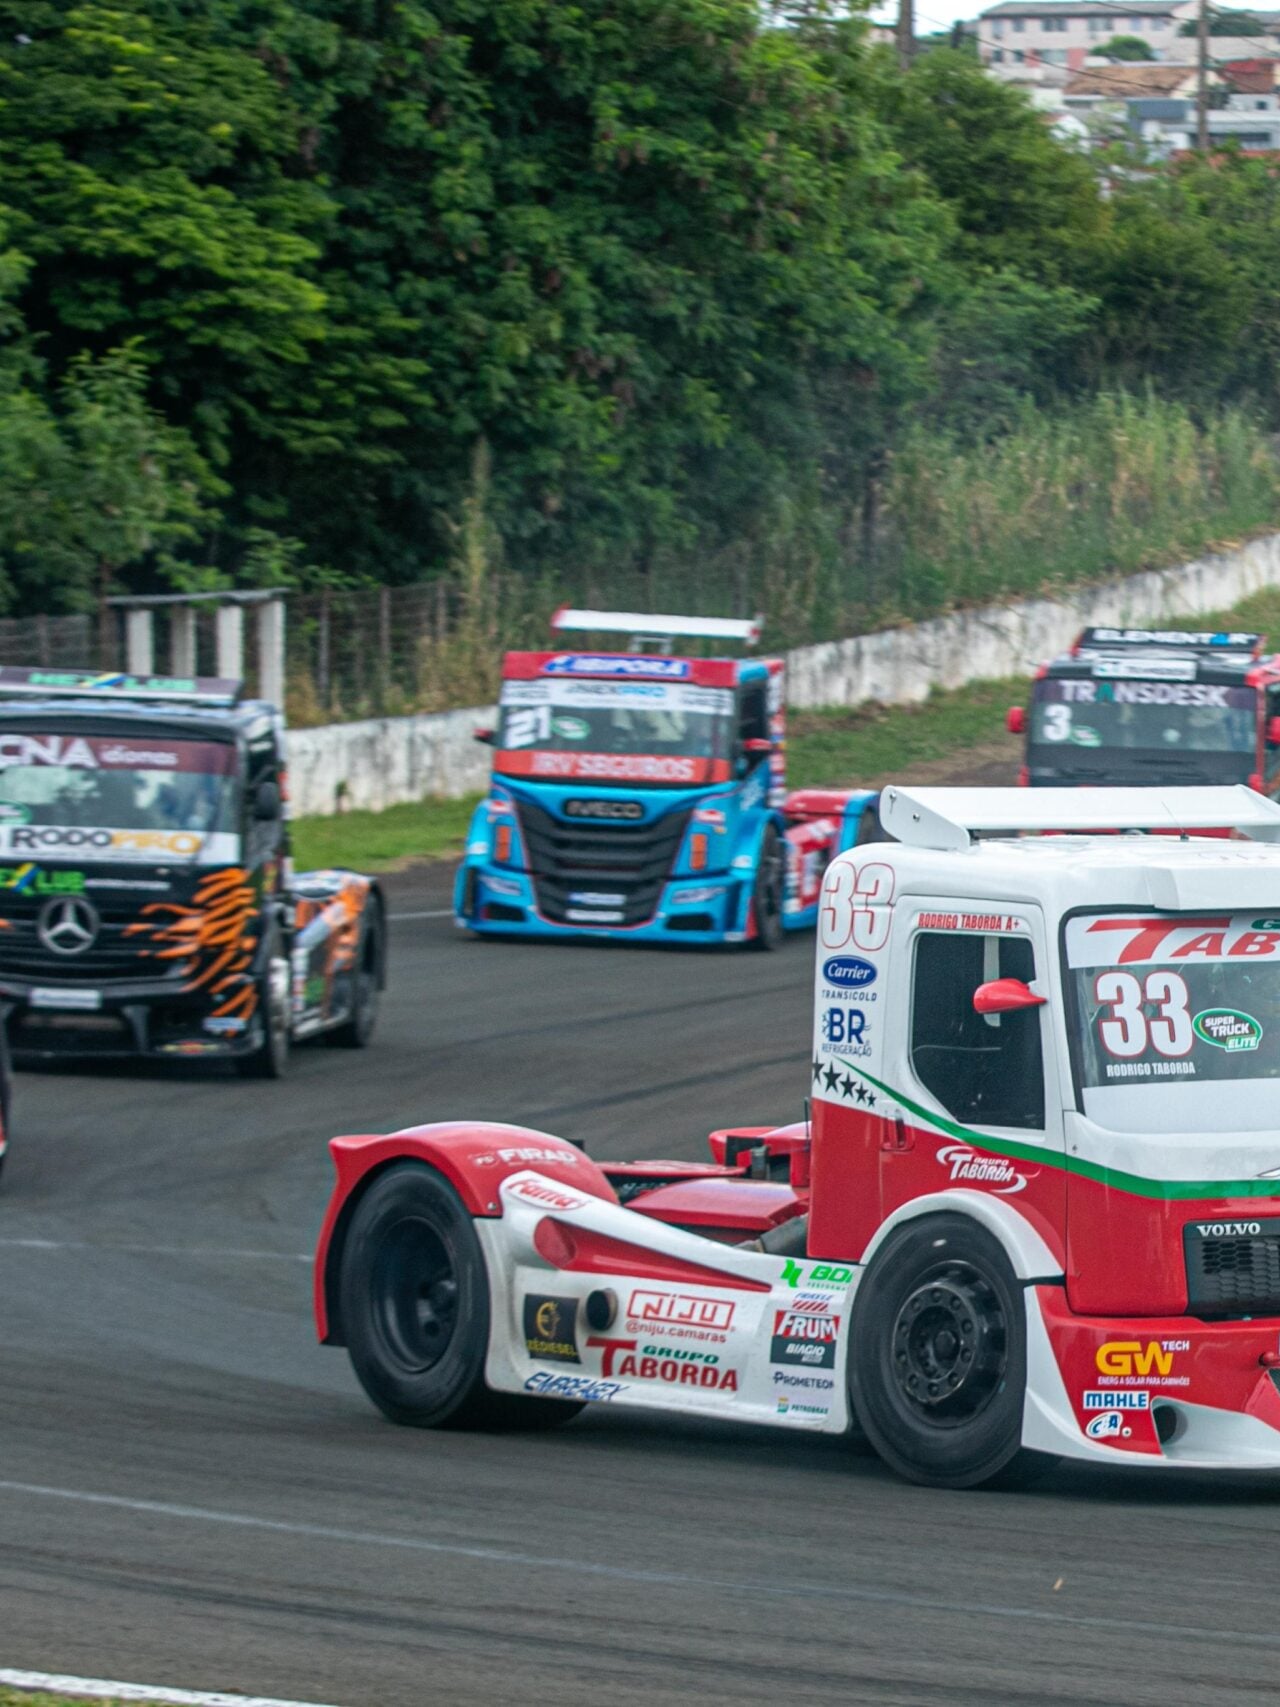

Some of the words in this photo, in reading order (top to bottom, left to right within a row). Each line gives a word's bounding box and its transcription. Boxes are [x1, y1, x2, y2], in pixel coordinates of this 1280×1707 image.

[1059, 680, 1230, 707] TRANSDESK
[506, 705, 551, 749] 21
[1044, 704, 1072, 741] 3
[577, 754, 694, 779] SEGUROS
[820, 861, 896, 951] 33
[918, 913, 957, 929] RODRIGO
[961, 914, 1002, 930] TABORDA
[828, 962, 871, 980] Carrier
[1096, 969, 1195, 1059] 33
[1205, 1015, 1235, 1027] SUPER
[828, 1007, 865, 1045] BR
[1211, 1023, 1250, 1037] TRUCK
[1227, 1037, 1257, 1049] ELITE
[1106, 1063, 1151, 1077] RODRIGO
[1152, 1061, 1196, 1075] TABORDA
[948, 1152, 1015, 1181] TABORDA
[1196, 1222, 1261, 1237] VOLVO
[626, 1319, 728, 1344] @niju.camaras
[642, 1345, 720, 1364] GRUPO
[785, 1343, 826, 1356] BIAGIO
[1162, 1340, 1190, 1351] TECH
[585, 1335, 738, 1392] TABORDA
[1095, 1341, 1174, 1376] GW
[1126, 1376, 1145, 1386] SOLAR
[1146, 1376, 1160, 1386] PARA
[1085, 1392, 1147, 1408] MAHLE
[791, 1404, 829, 1415] PETROBRAS
